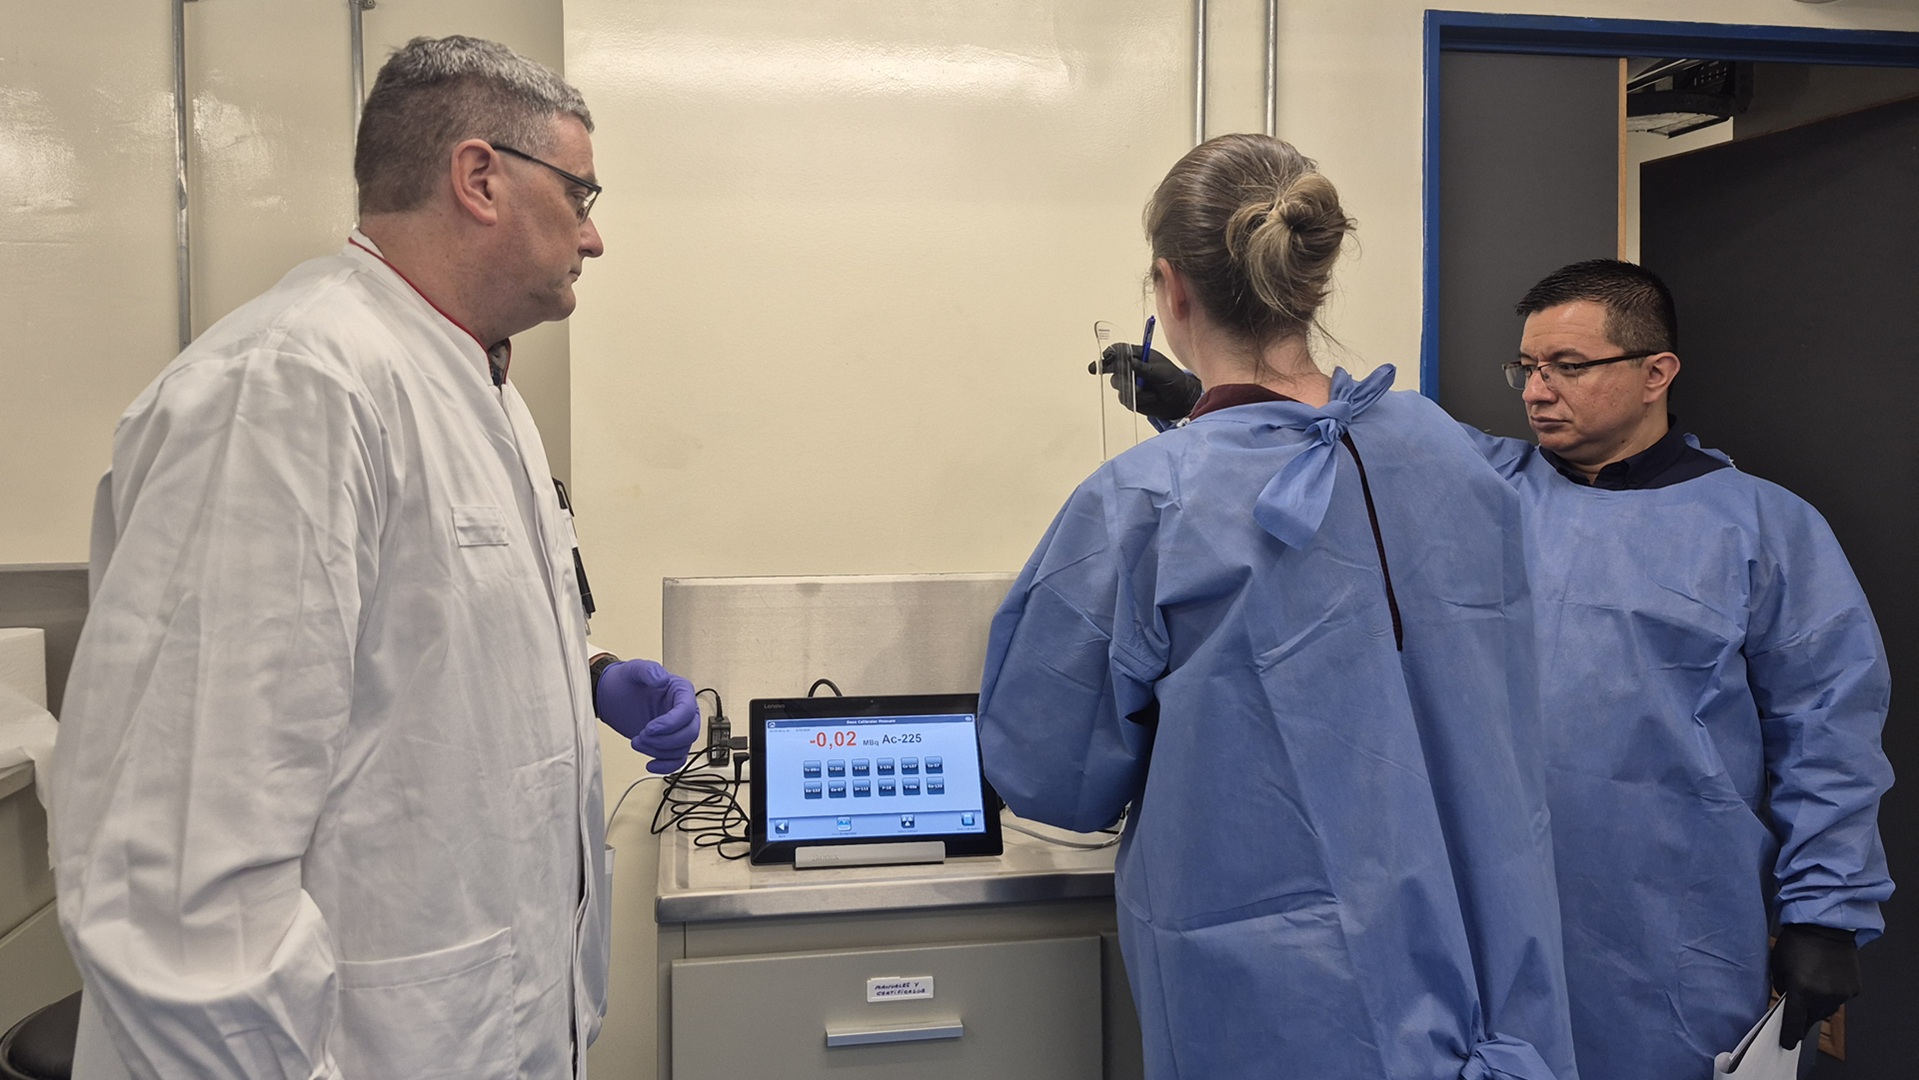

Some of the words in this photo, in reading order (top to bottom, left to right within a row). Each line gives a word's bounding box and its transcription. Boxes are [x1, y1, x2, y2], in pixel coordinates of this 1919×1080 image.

[809, 730, 857, 750] -0,02
[863, 739, 879, 747] MBq
[882, 733, 922, 744] Ac-225
[875, 982, 909, 990] MANUALES
